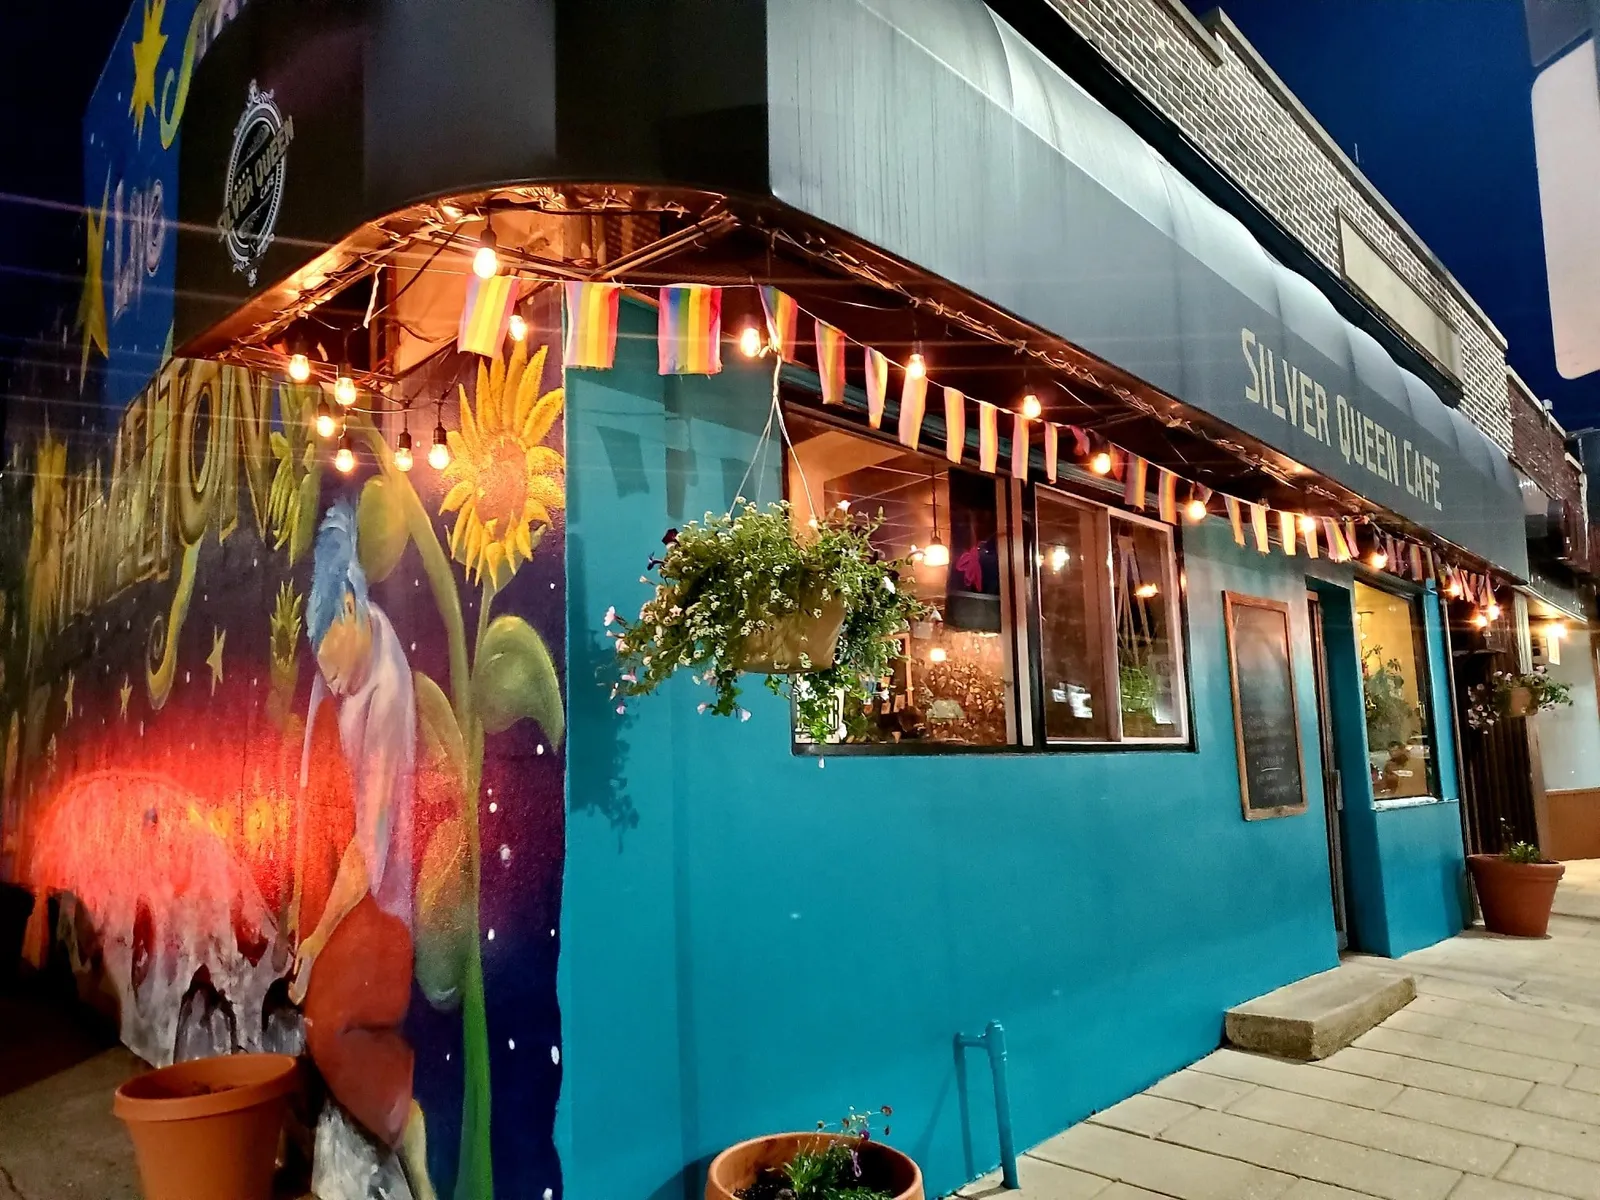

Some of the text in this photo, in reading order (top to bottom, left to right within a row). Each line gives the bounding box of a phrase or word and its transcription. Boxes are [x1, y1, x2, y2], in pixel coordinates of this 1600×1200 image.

[255, 114, 295, 187] QUEEN
[259, 172, 275, 200] CAFE
[1241, 327, 1443, 511] SILVER QUEEN CAFE
